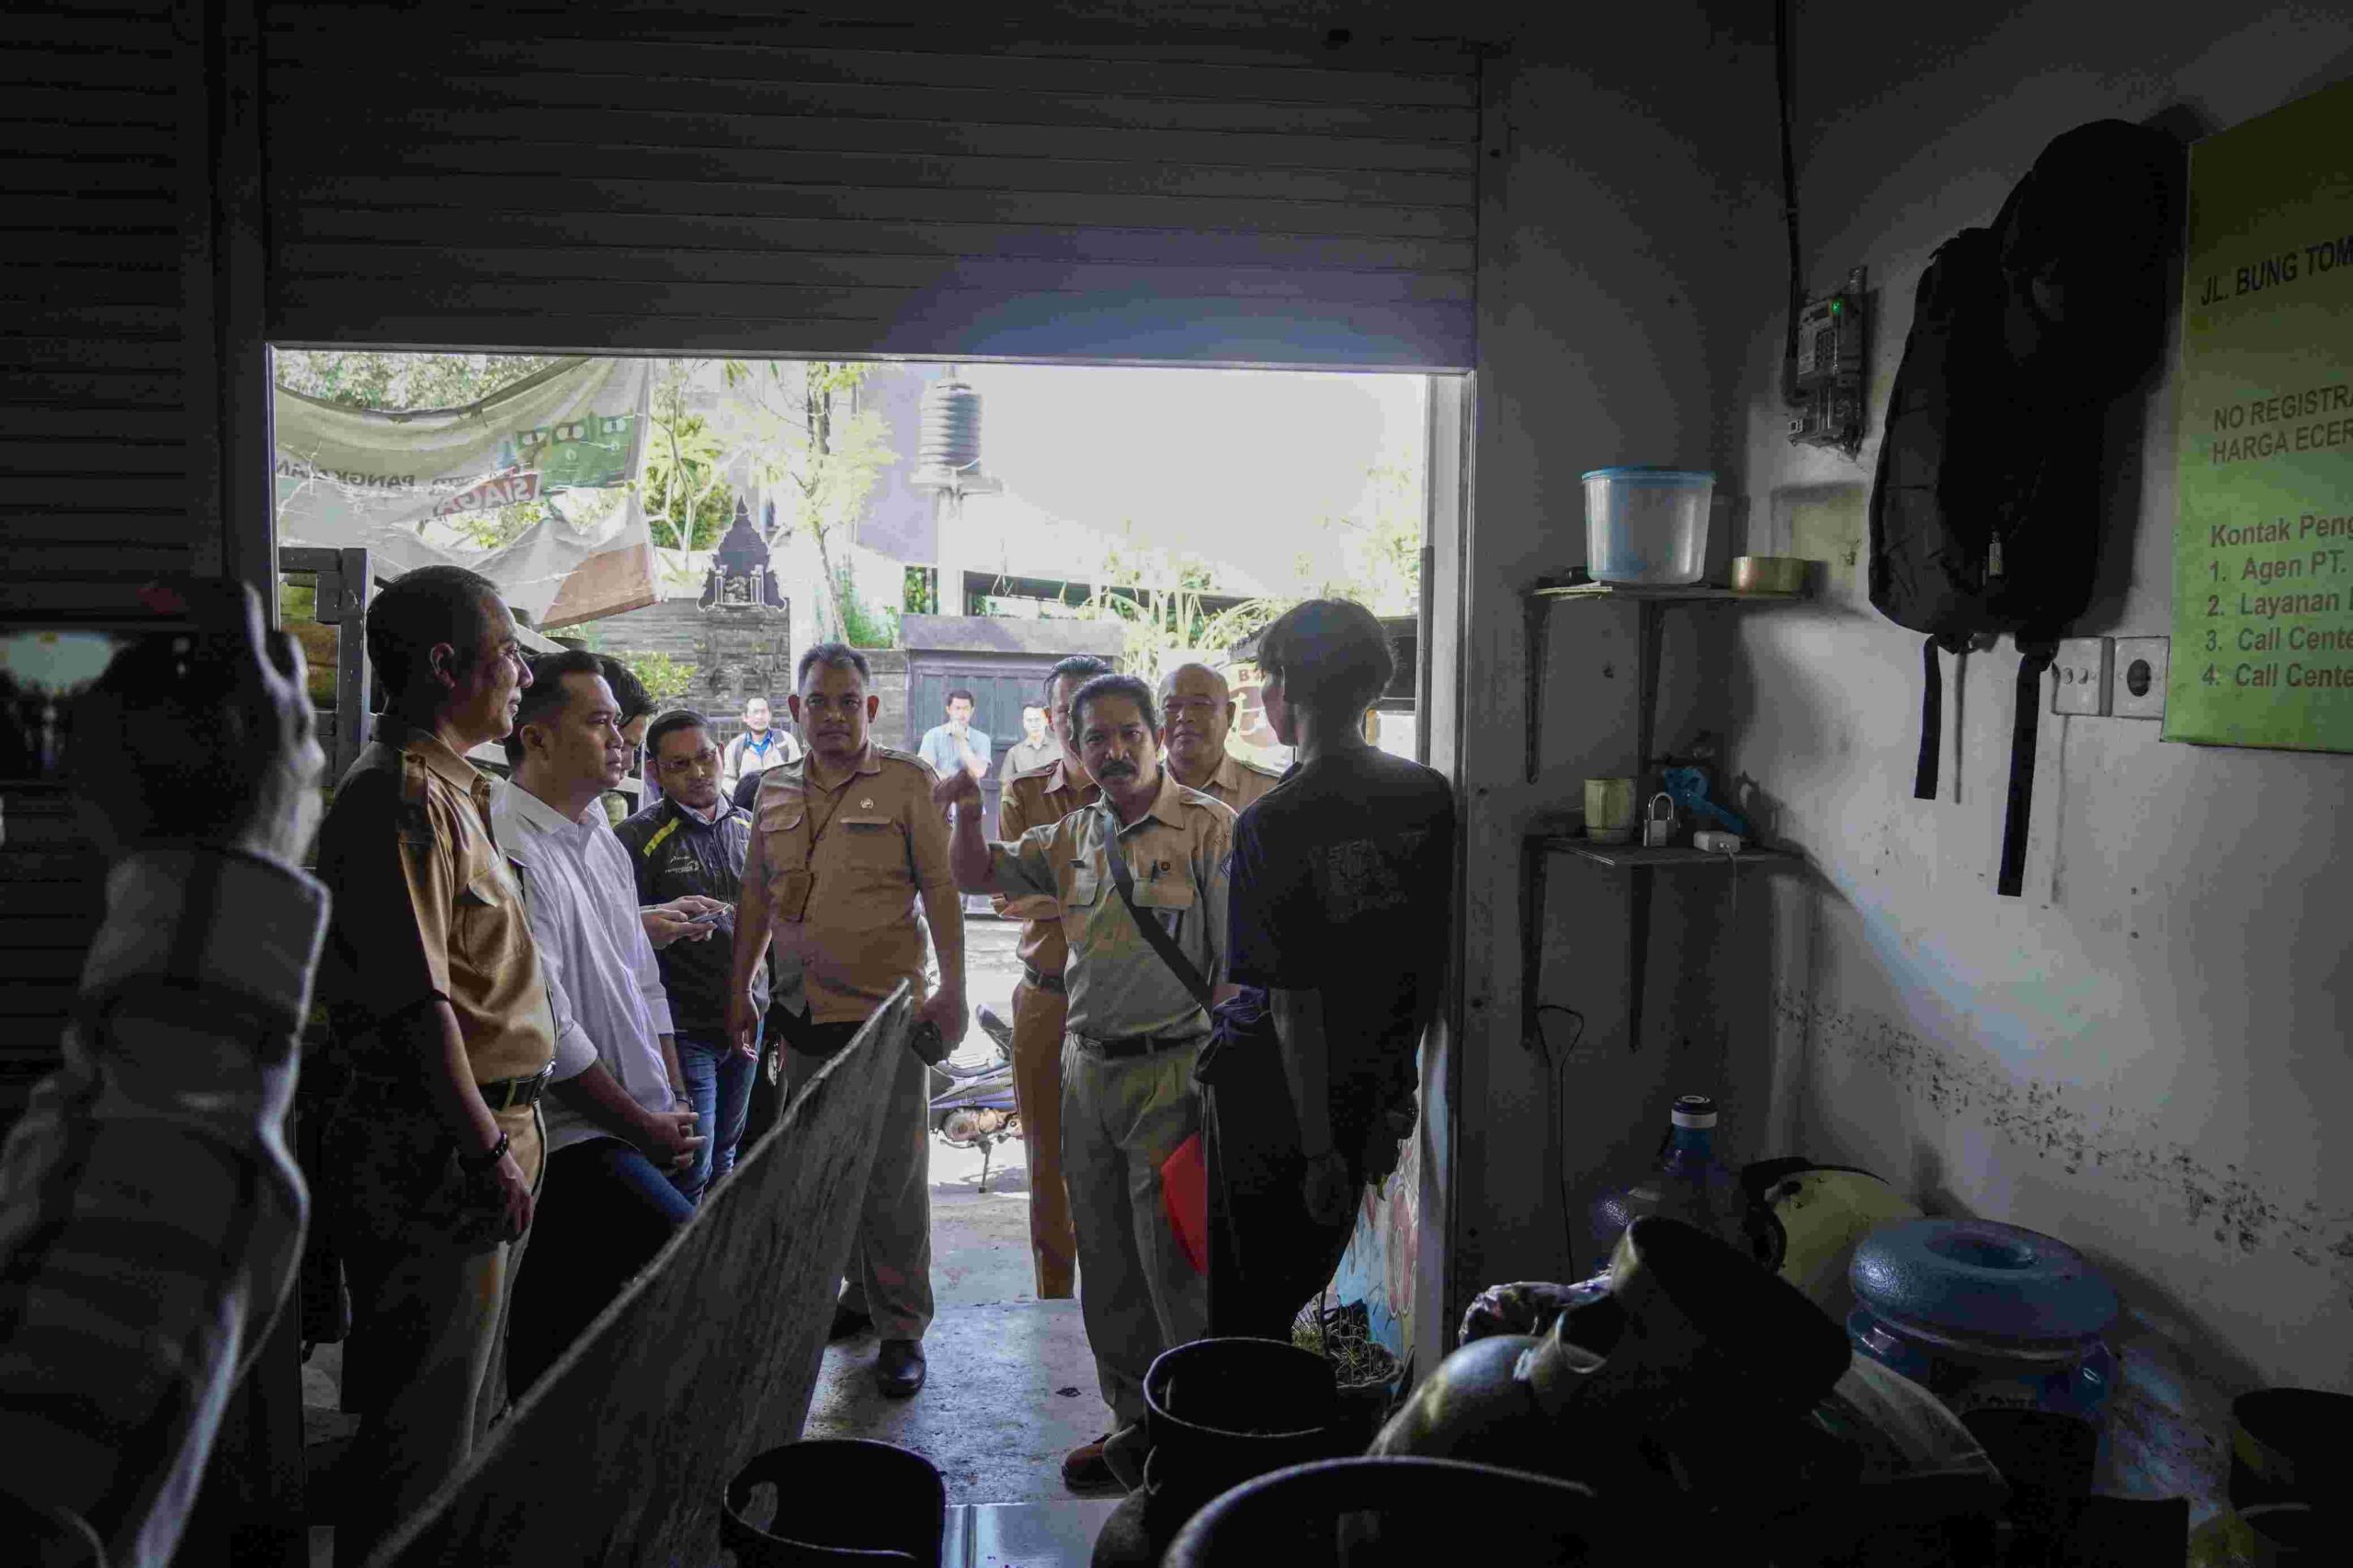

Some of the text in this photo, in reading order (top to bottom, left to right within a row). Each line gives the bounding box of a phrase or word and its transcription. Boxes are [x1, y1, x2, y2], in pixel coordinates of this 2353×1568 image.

[2200, 276, 2229, 306] JL.
[2235, 252, 2297, 296] BUNG
[2213, 404, 2245, 432] NO
[2212, 430, 2290, 464] HARGA
[2210, 517, 2291, 548] Kontak
[2210, 549, 2347, 585] 1. Agen PT.
[2207, 594, 2225, 617] 2.
[2240, 592, 2340, 620] Layanan
[2206, 629, 2222, 652] 3.
[2238, 626, 2281, 652] Call
[2201, 663, 2220, 687] 4.
[2234, 662, 2279, 687] Call
